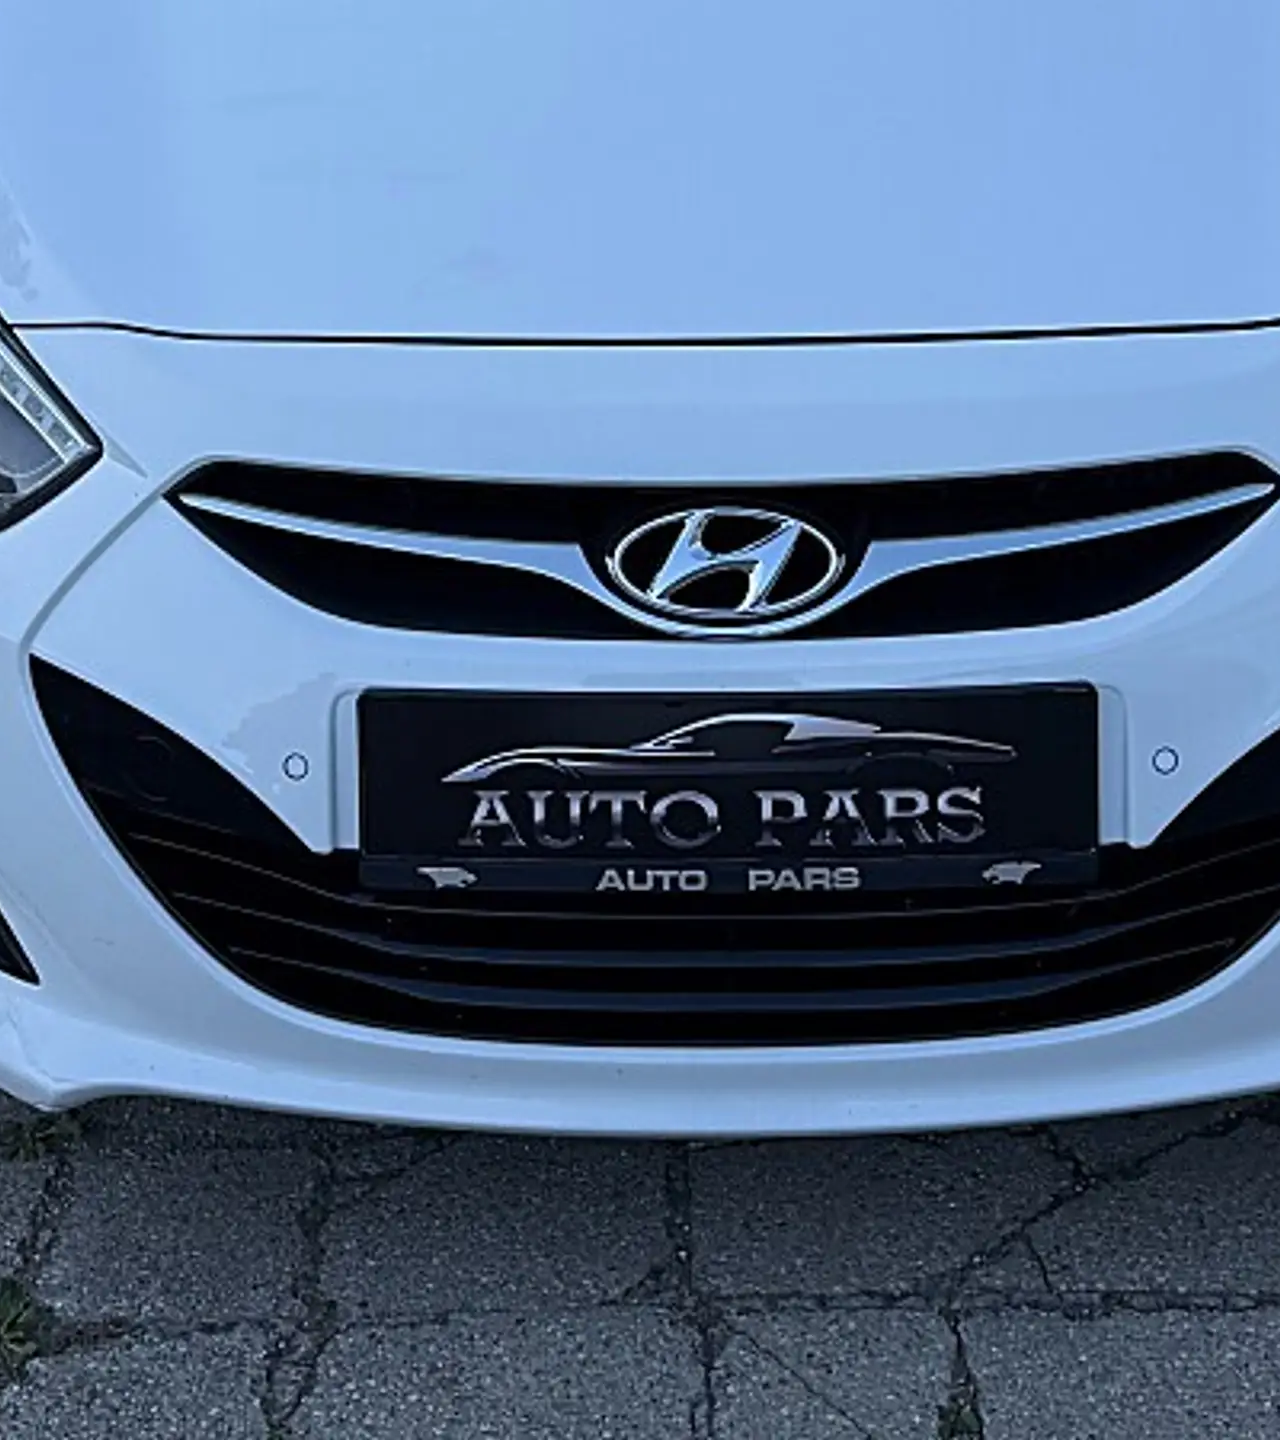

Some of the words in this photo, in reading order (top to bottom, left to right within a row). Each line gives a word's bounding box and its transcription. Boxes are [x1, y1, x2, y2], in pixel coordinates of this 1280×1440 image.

[458, 789, 721, 849] AUTO
[752, 786, 987, 849] PARS
[596, 867, 707, 891] AUTO
[748, 866, 861, 891] PARS
